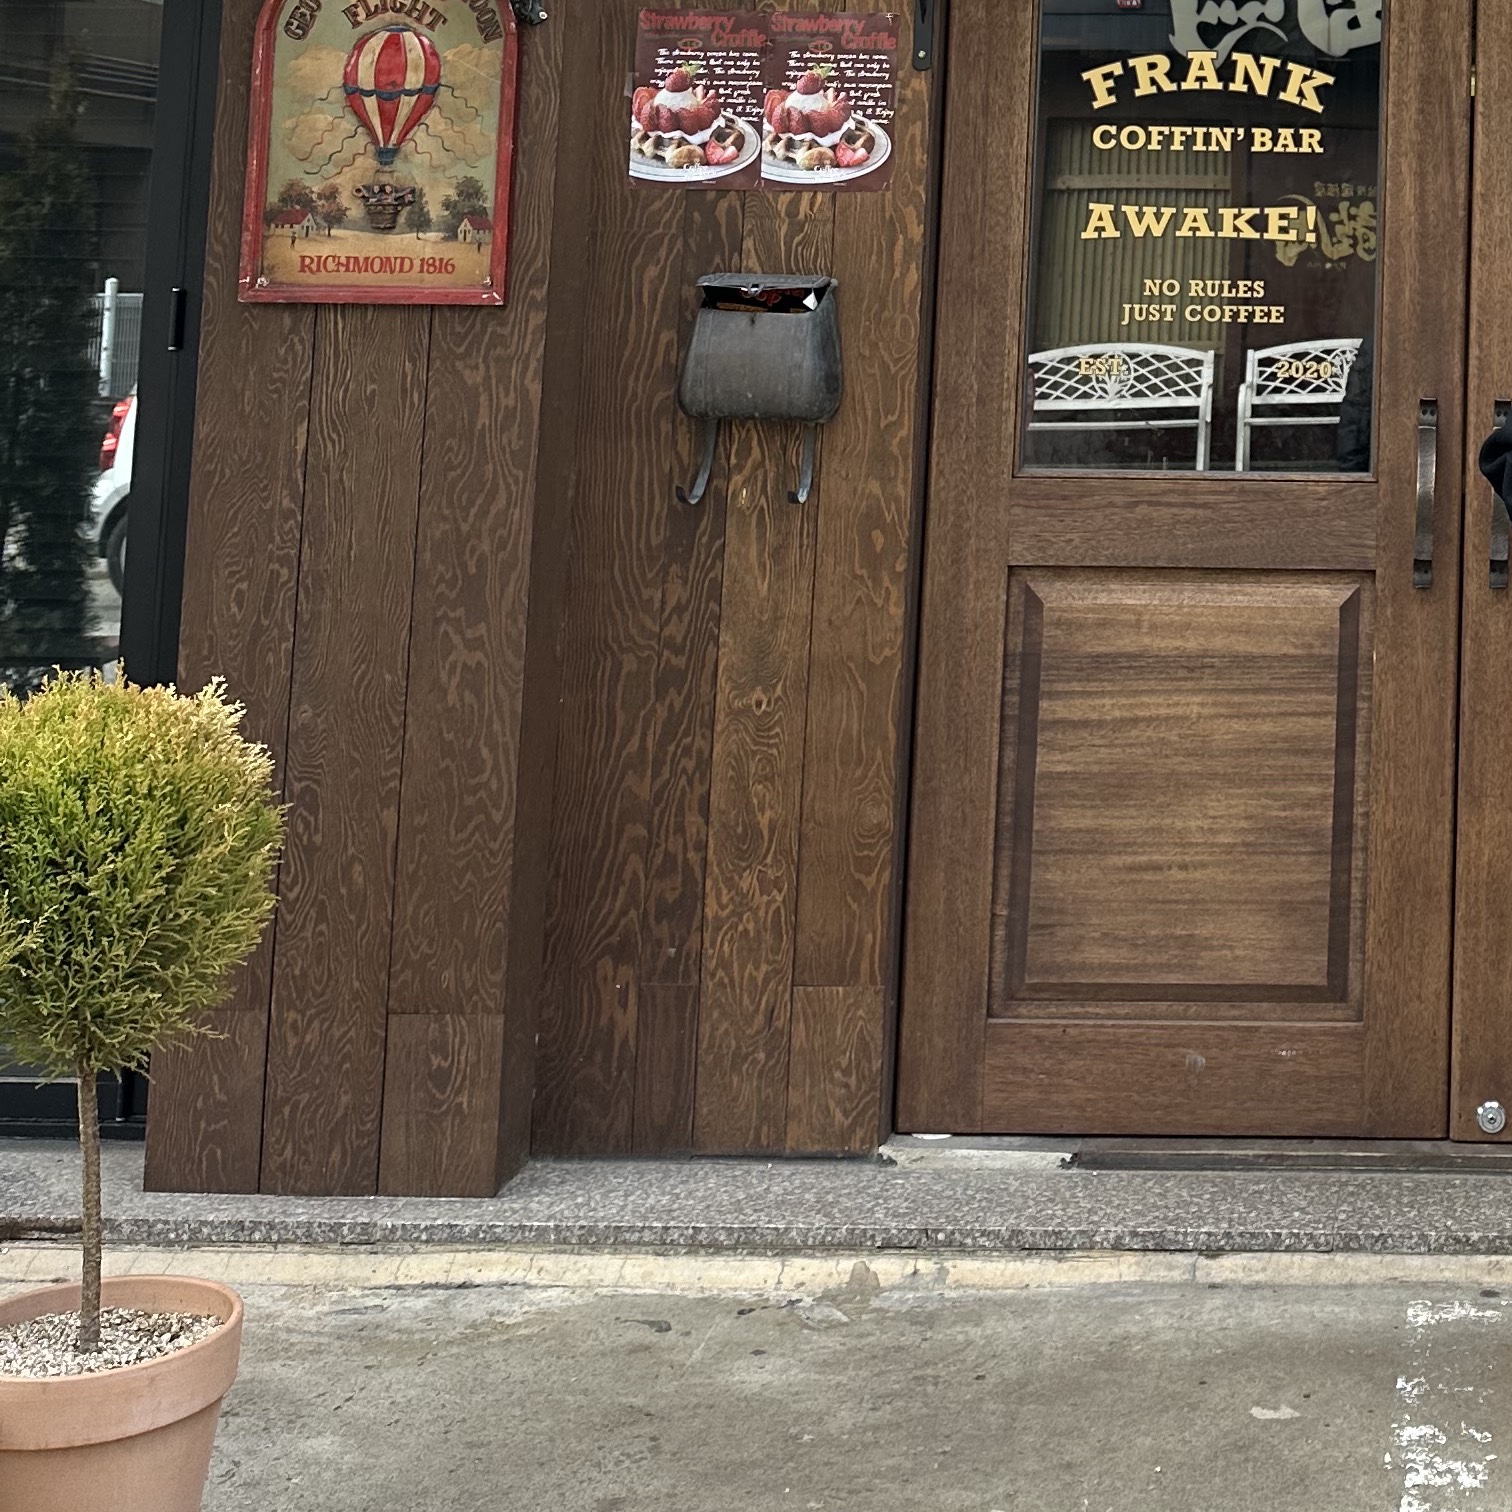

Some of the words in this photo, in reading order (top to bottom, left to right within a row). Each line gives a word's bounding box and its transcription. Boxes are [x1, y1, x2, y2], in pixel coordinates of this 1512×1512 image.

[1081, 50, 1336, 114] FRANK
[1092, 124, 1246, 153] COFFIN'
[1251, 127, 1325, 155] BAR
[1081, 202, 1318, 243] AWAKE!
[299, 254, 414, 275] RICHMOND
[417, 256, 456, 275] 1816
[1143, 279, 1181, 298] NO
[1188, 279, 1265, 299] RULES
[1121, 303, 1177, 324] JUST
[1185, 303, 1286, 324] COFFEE
[1276, 359, 1333, 379] 2020
